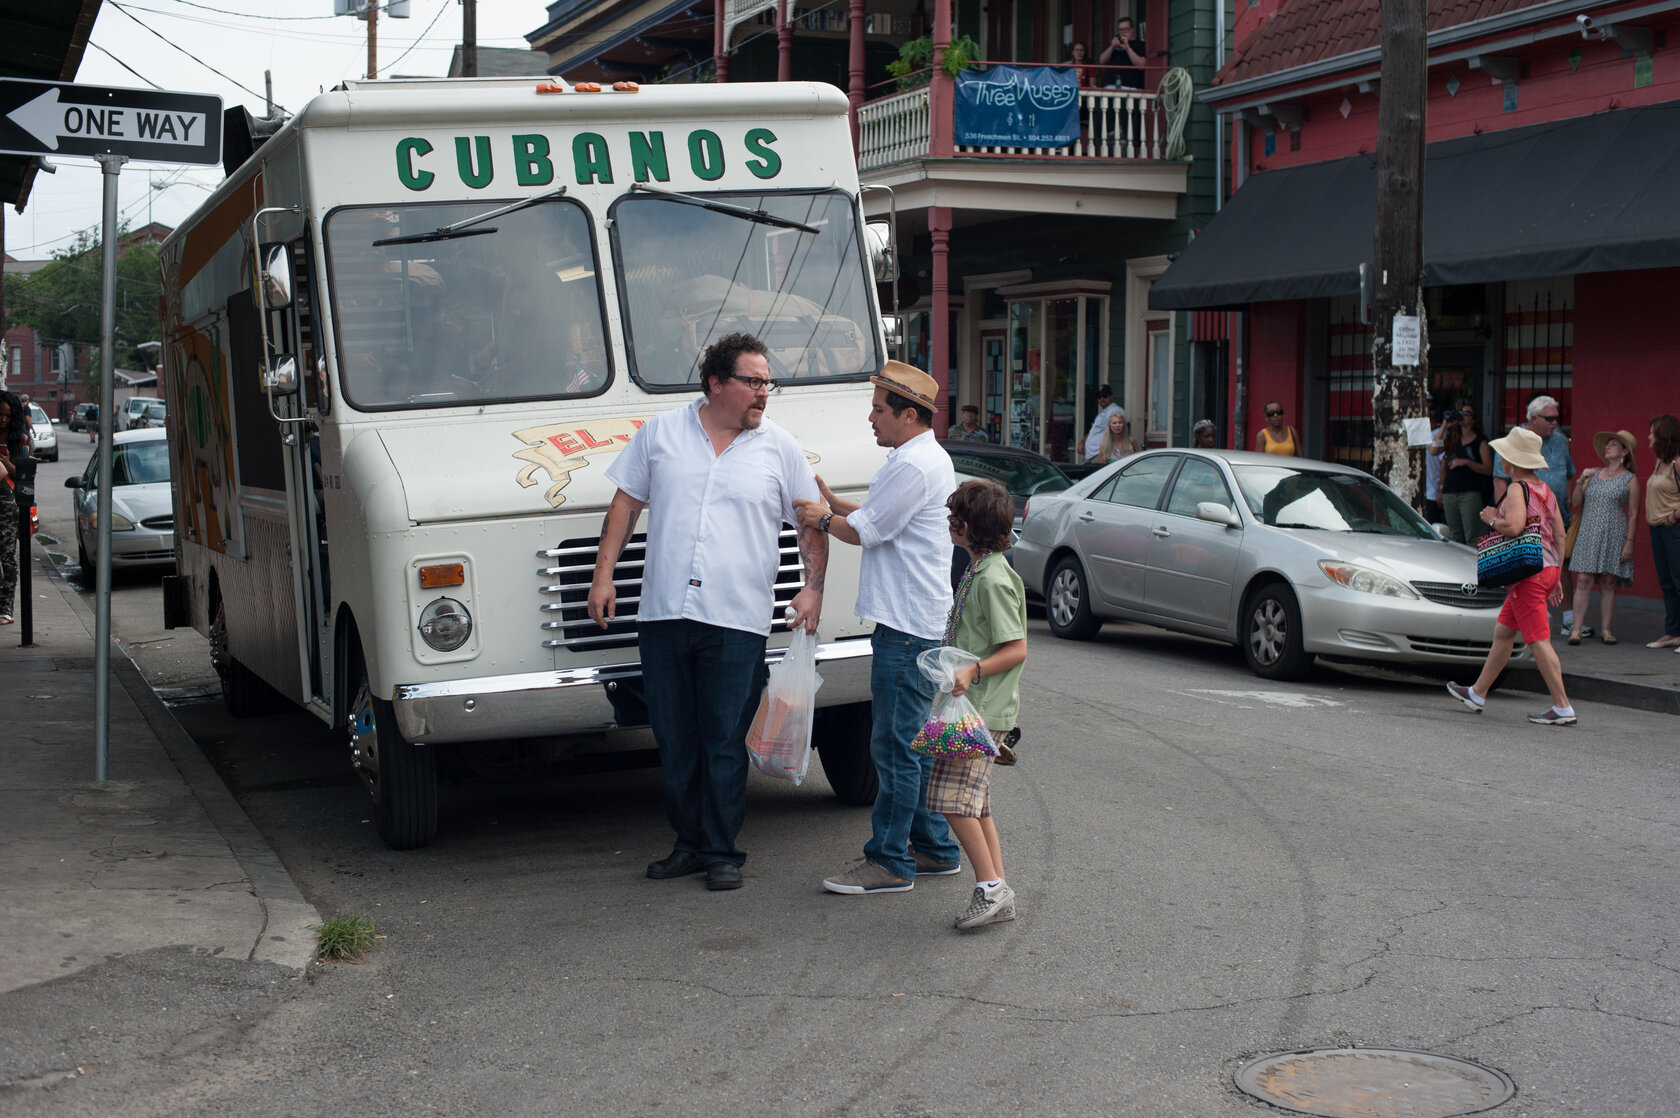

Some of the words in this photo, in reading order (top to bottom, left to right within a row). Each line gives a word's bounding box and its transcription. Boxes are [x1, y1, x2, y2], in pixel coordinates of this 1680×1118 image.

[960, 77, 1016, 106] Three
[1014, 73, 1076, 111] Muses
[64, 106, 125, 137] ONE
[136, 111, 198, 142] WAY
[396, 127, 782, 192] CUBANOS
[546, 429, 613, 457] EL
